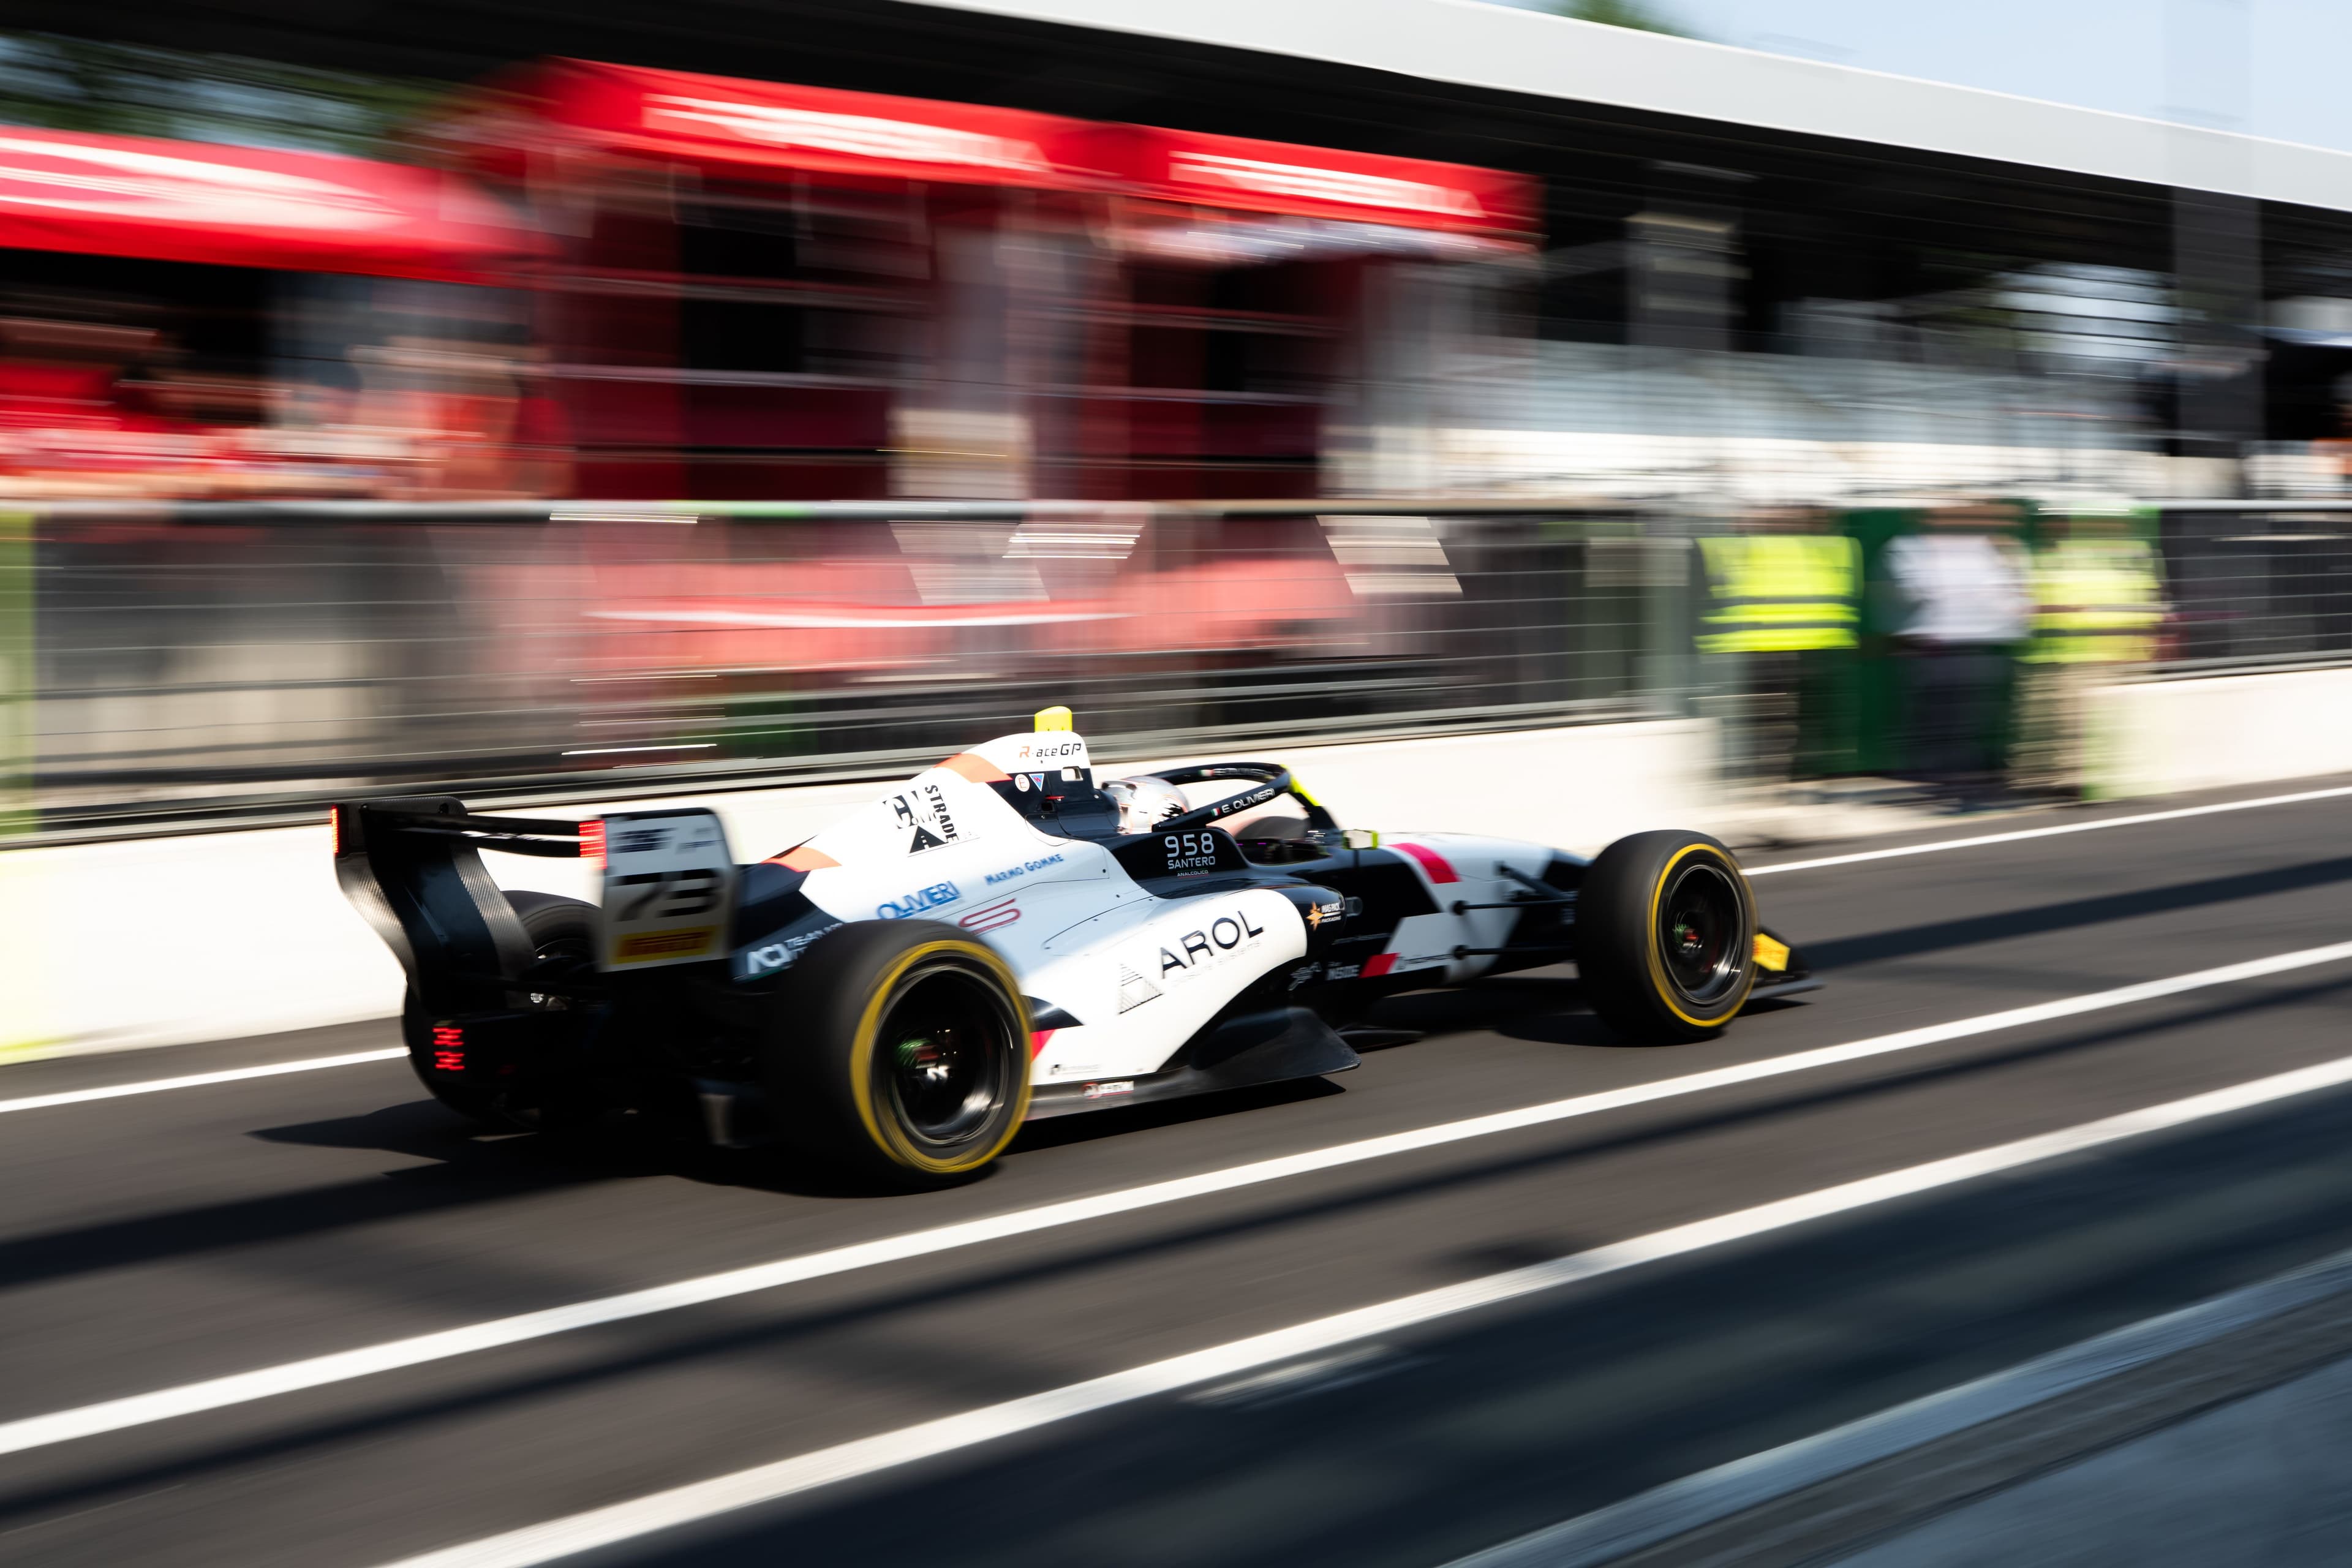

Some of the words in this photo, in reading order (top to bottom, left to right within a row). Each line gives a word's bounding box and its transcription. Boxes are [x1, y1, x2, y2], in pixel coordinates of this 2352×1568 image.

[925, 785, 960, 843] STRADE
[1233, 788, 1275, 809] OLIVIERI
[985, 867, 1024, 886] MARMO
[1025, 854, 1064, 872] GOMME
[1167, 856, 1216, 870] SANTERO
[876, 881, 960, 919] OLIVIERI
[1160, 910, 1264, 979] AROL
